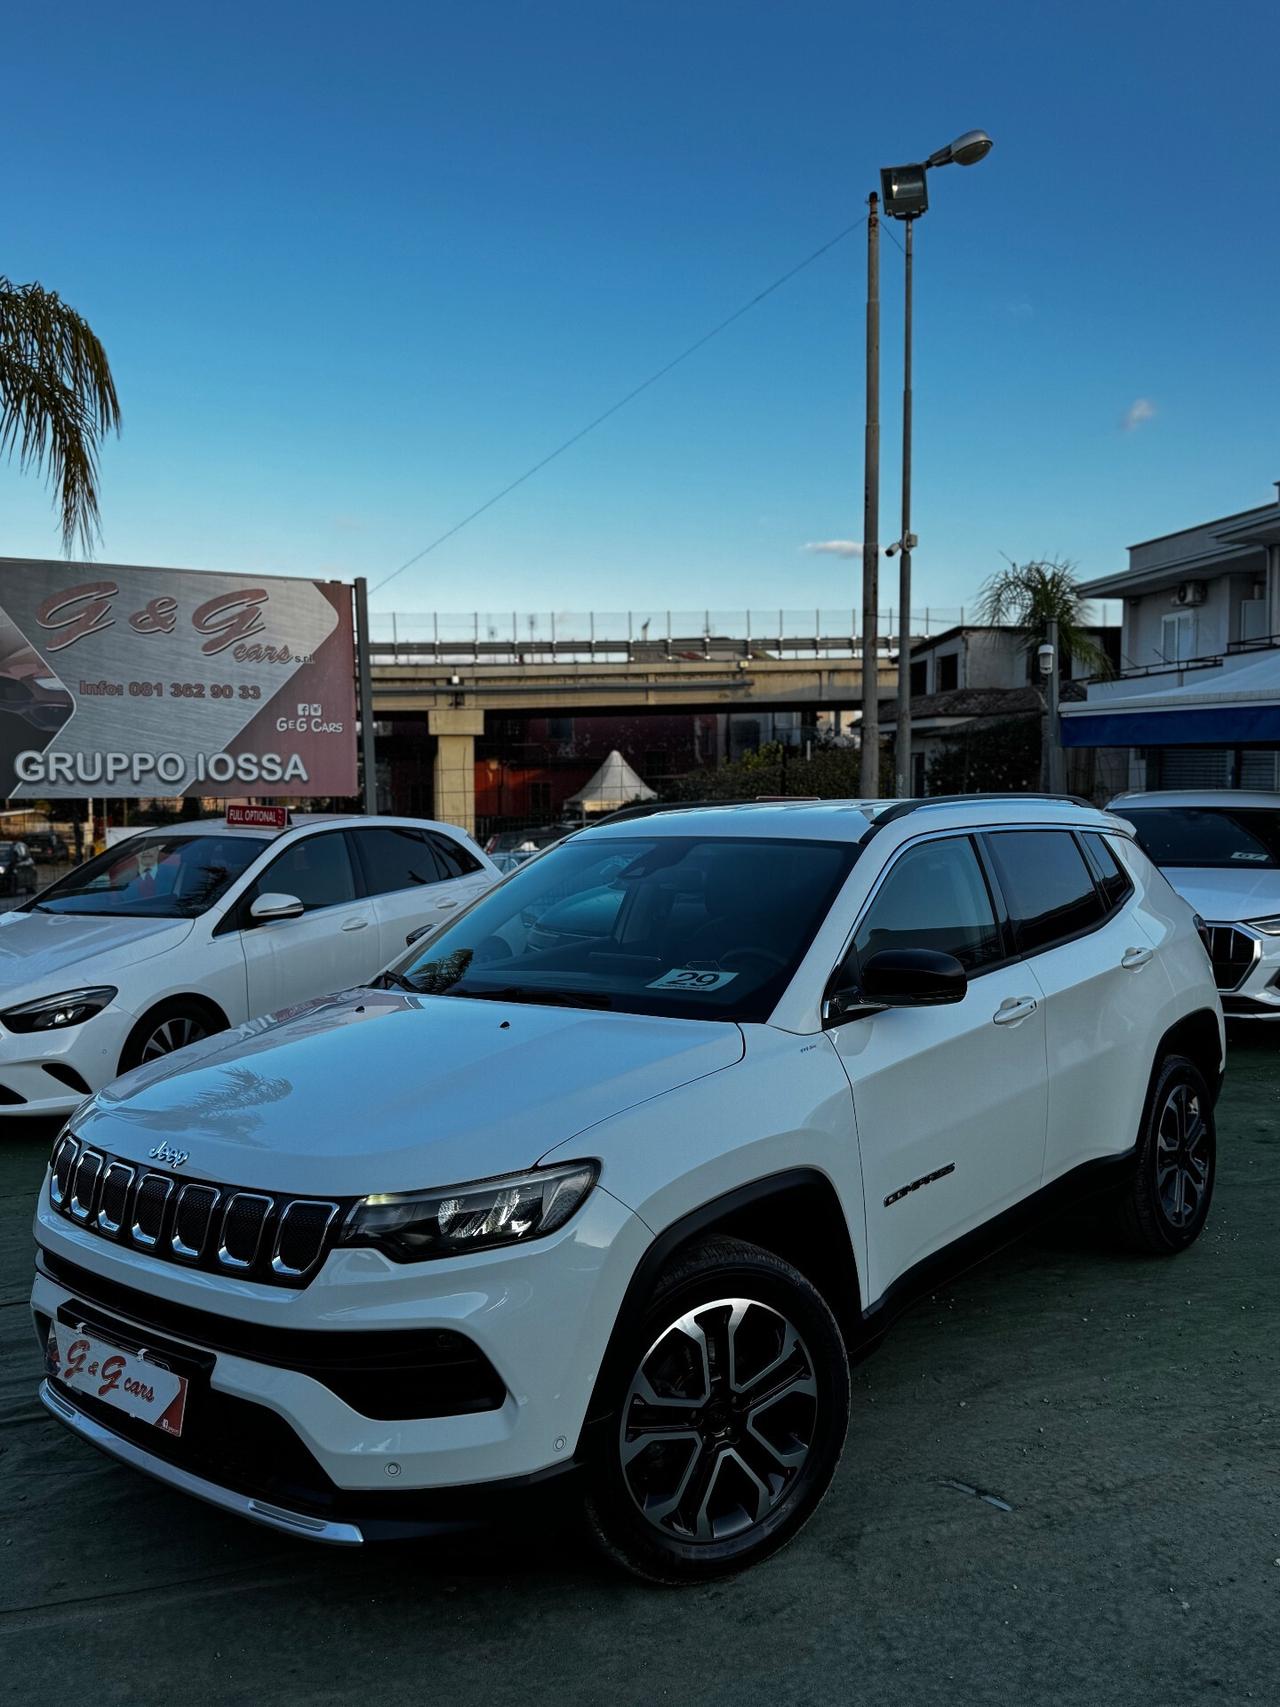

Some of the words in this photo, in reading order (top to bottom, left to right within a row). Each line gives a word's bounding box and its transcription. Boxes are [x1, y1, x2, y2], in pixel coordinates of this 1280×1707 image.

[36, 581, 119, 652] G
[129, 596, 178, 634] &
[192, 588, 269, 656] G
[233, 643, 293, 665] cars
[79, 680, 124, 696] Info:
[128, 681, 164, 697] 081
[210, 684, 234, 699] 90
[238, 685, 261, 700] 33
[14, 751, 186, 784] GRUPPO
[198, 753, 309, 783] IOSSA
[229, 809, 244, 821] FULL
[244, 810, 277, 823] OPTIONAL
[666, 972, 720, 987] 29
[149, 1140, 189, 1168] Jeep
[64, 1339, 91, 1379] G
[87, 1361, 99, 1377] &
[98, 1355, 127, 1396] G
[123, 1377, 155, 1403] cars
